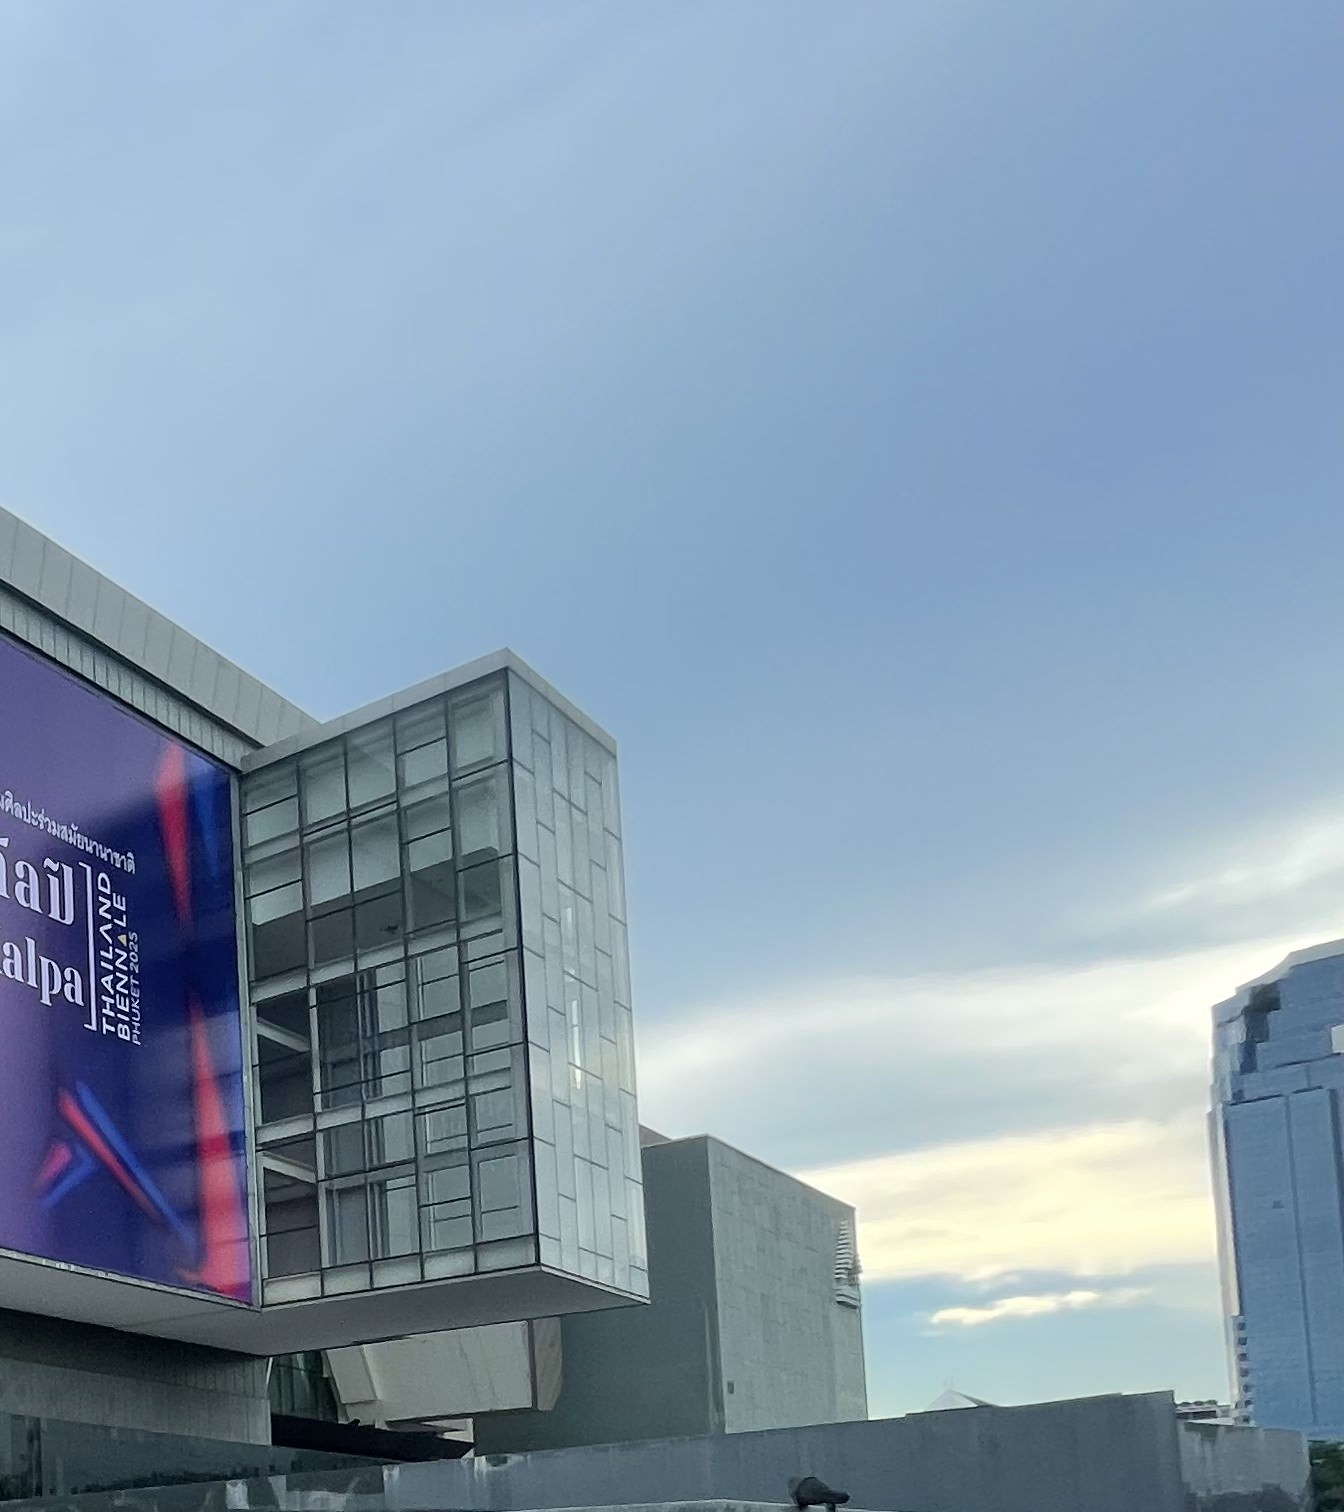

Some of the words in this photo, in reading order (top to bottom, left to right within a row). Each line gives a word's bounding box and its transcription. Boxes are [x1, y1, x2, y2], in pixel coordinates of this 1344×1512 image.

[97, 872, 116, 1035] THAILAND
[128, 930, 140, 974] 2025
[129, 975, 142, 1046] PHUKET
